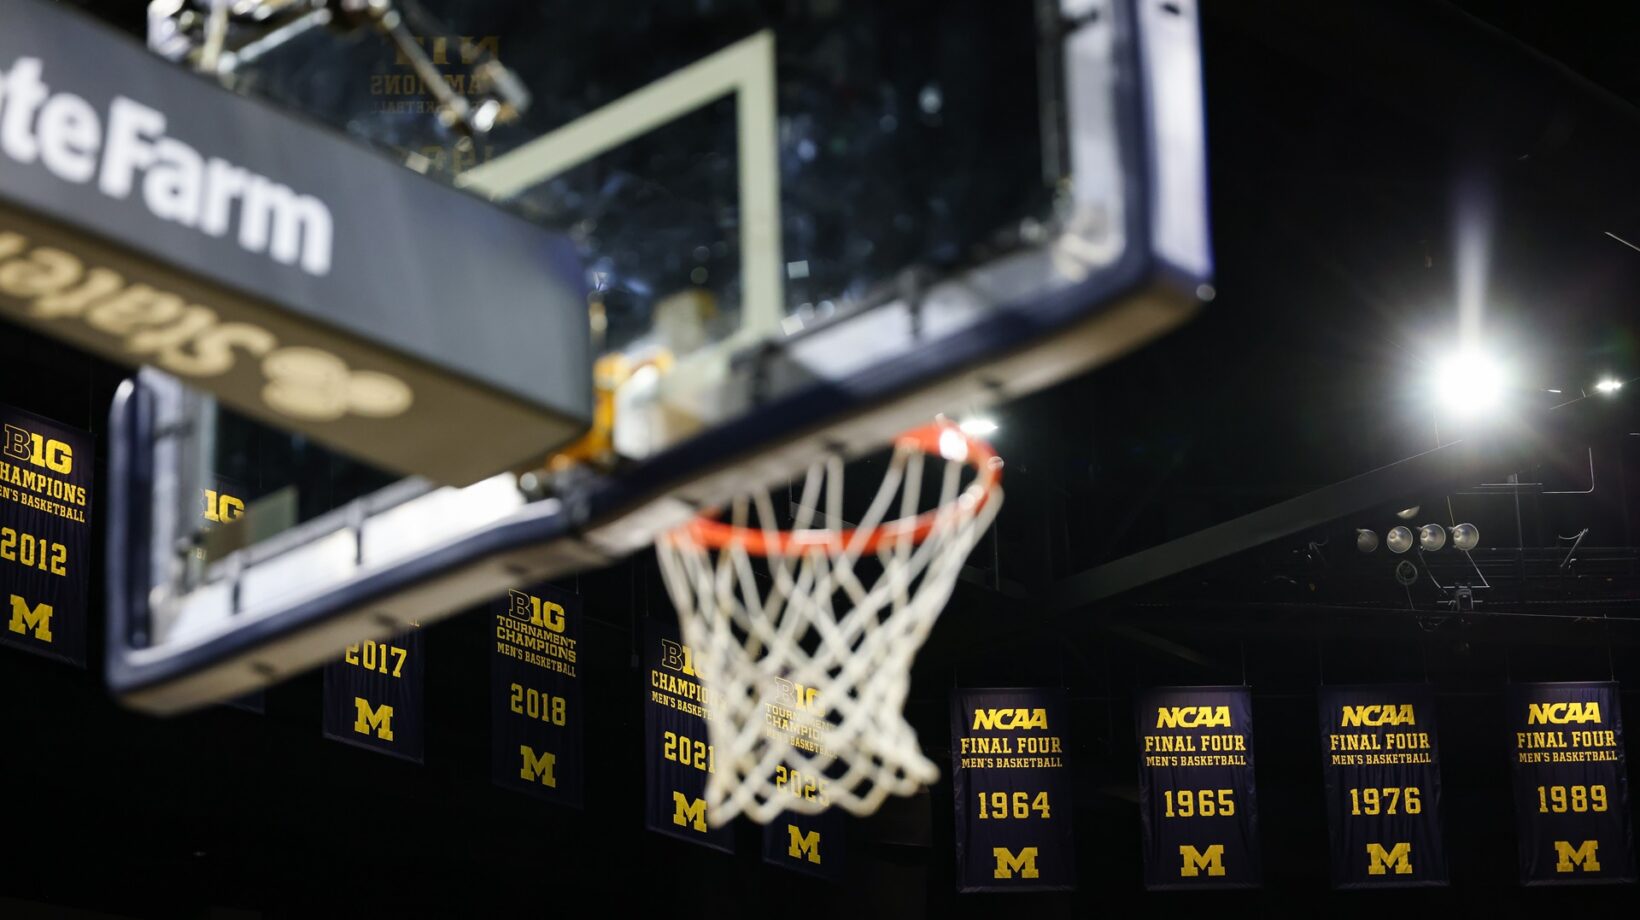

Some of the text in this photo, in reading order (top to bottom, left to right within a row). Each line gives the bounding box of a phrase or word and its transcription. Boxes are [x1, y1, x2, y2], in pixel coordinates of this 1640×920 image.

[0, 56, 334, 276] teFarm
[0, 231, 277, 376] State
[21, 492, 85, 523] BASKETBALL
[1, 527, 67, 576] 2012
[9, 594, 53, 642] M
[496, 615, 576, 650] TOURNAMENT
[345, 640, 407, 678] 2017
[497, 626, 576, 663] CHAMPIONS
[497, 642, 576, 678] MEN'S BASKETBALL
[652, 669, 714, 705] CHAMPIO
[652, 691, 676, 709] MEN'S
[354, 698, 393, 740] M
[511, 683, 565, 726] 2018
[973, 708, 1047, 730] NCAA
[1157, 706, 1231, 728] NCAA
[1342, 704, 1415, 727] NCAA
[1528, 702, 1601, 724] NCAA
[664, 732, 715, 774] 2021
[961, 736, 1062, 754] FINAL FOUR
[1145, 735, 1246, 752] FINAL FOUR
[1330, 732, 1431, 751] FINAL FOUR
[1517, 730, 1616, 748] FINAL FOUR
[521, 745, 556, 787] M
[961, 757, 1063, 769] MEN'S BASKETBALL
[1146, 755, 1246, 767] MEN'S BASKETBALL
[1331, 753, 1431, 765] MEN'S BASKETBALL
[1519, 750, 1618, 762] MEN'S BASKETBALL
[776, 765, 830, 807] 2025
[1350, 787, 1421, 815] 1976
[1538, 785, 1608, 813] 1989
[673, 791, 707, 833] M
[979, 792, 1050, 819] 1964
[1165, 789, 1235, 817] 1965
[788, 825, 820, 864] M
[1179, 844, 1225, 876] M
[1366, 843, 1412, 875] M
[1554, 840, 1600, 872] M
[993, 847, 1039, 879] M
